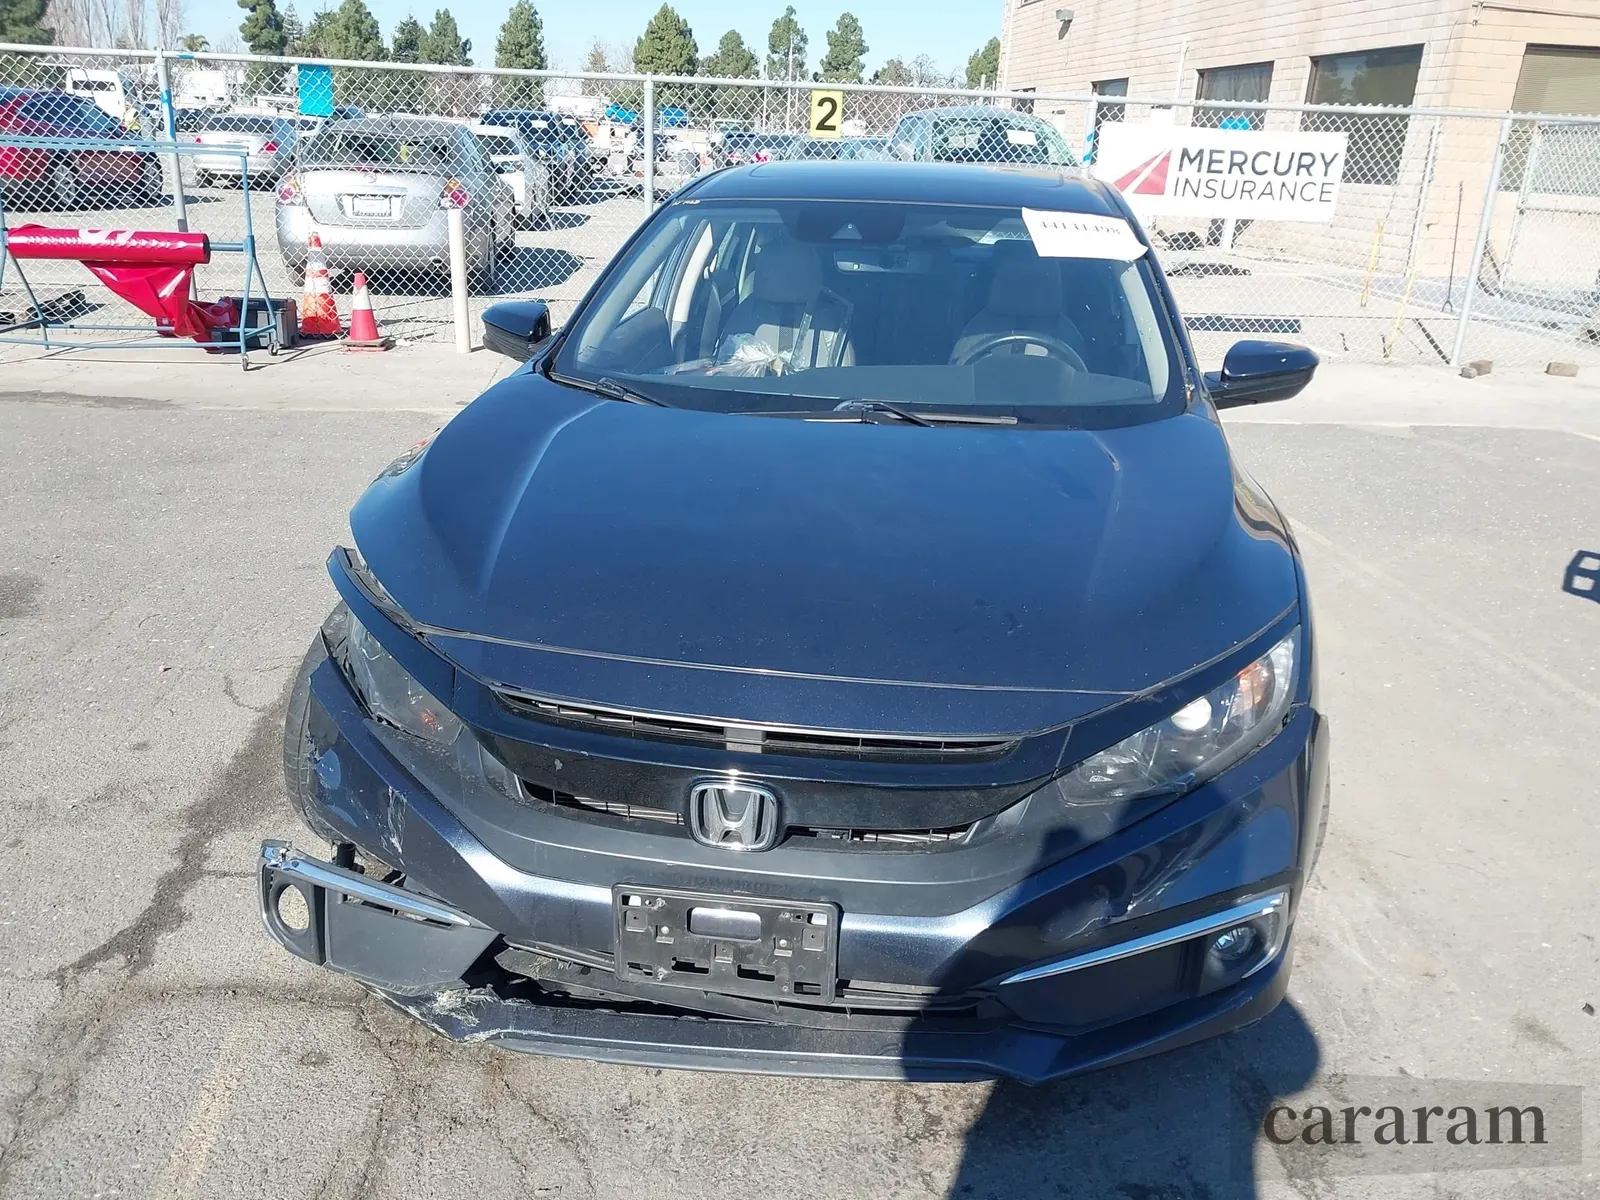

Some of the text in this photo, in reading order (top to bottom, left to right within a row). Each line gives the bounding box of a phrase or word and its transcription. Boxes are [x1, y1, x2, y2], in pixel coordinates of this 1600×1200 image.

[815, 96, 838, 131] 2
[1178, 147, 1339, 177] MERCURY
[1173, 177, 1335, 203] INSURANCE
